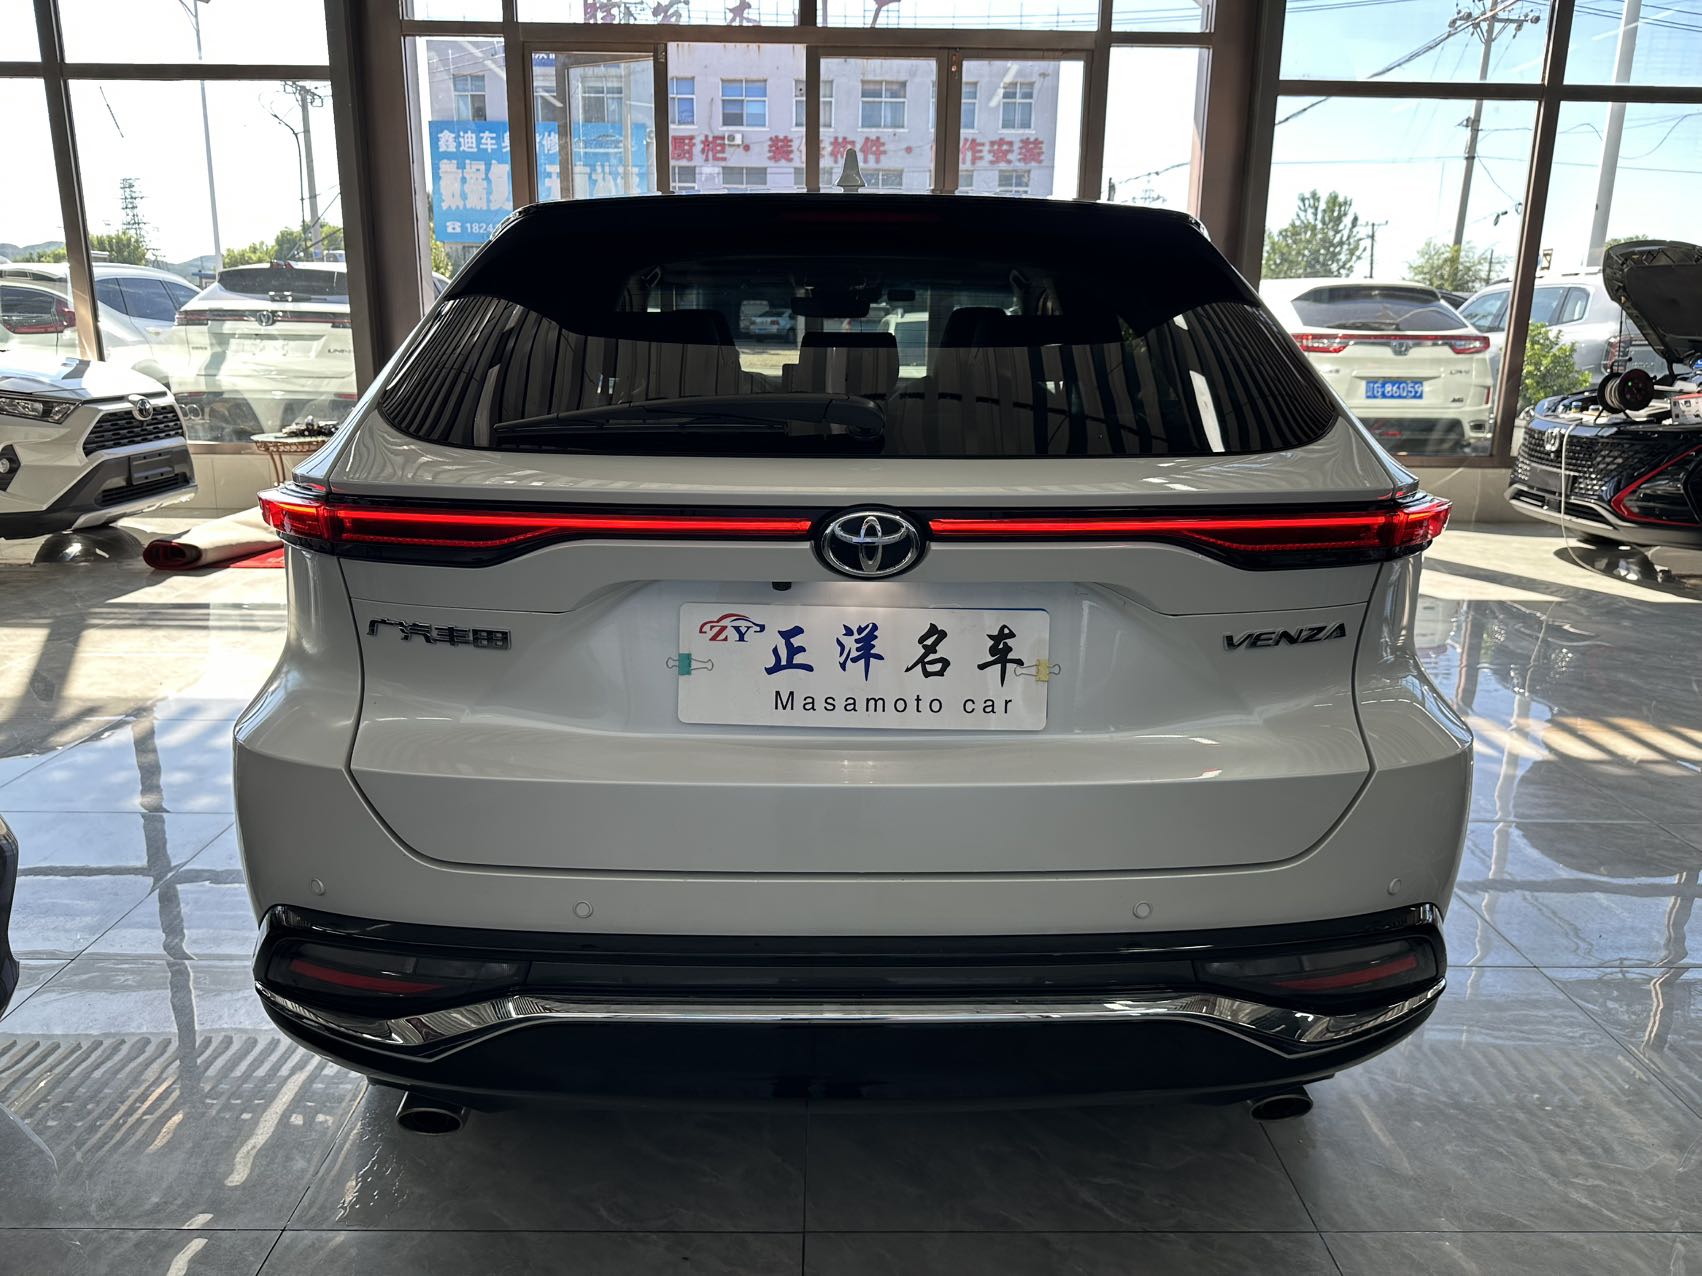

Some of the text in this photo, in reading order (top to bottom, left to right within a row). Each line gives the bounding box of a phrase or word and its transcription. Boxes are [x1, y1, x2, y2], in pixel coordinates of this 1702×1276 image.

[438, 129, 559, 153] 鑫迪车修
[465, 222, 494, 234] 1824
[367, 618, 512, 650] 广汽丰田
[1222, 622, 1347, 651] VENZA
[764, 622, 1025, 687] 正洋名车
[774, 690, 1014, 714] Masamoto car
